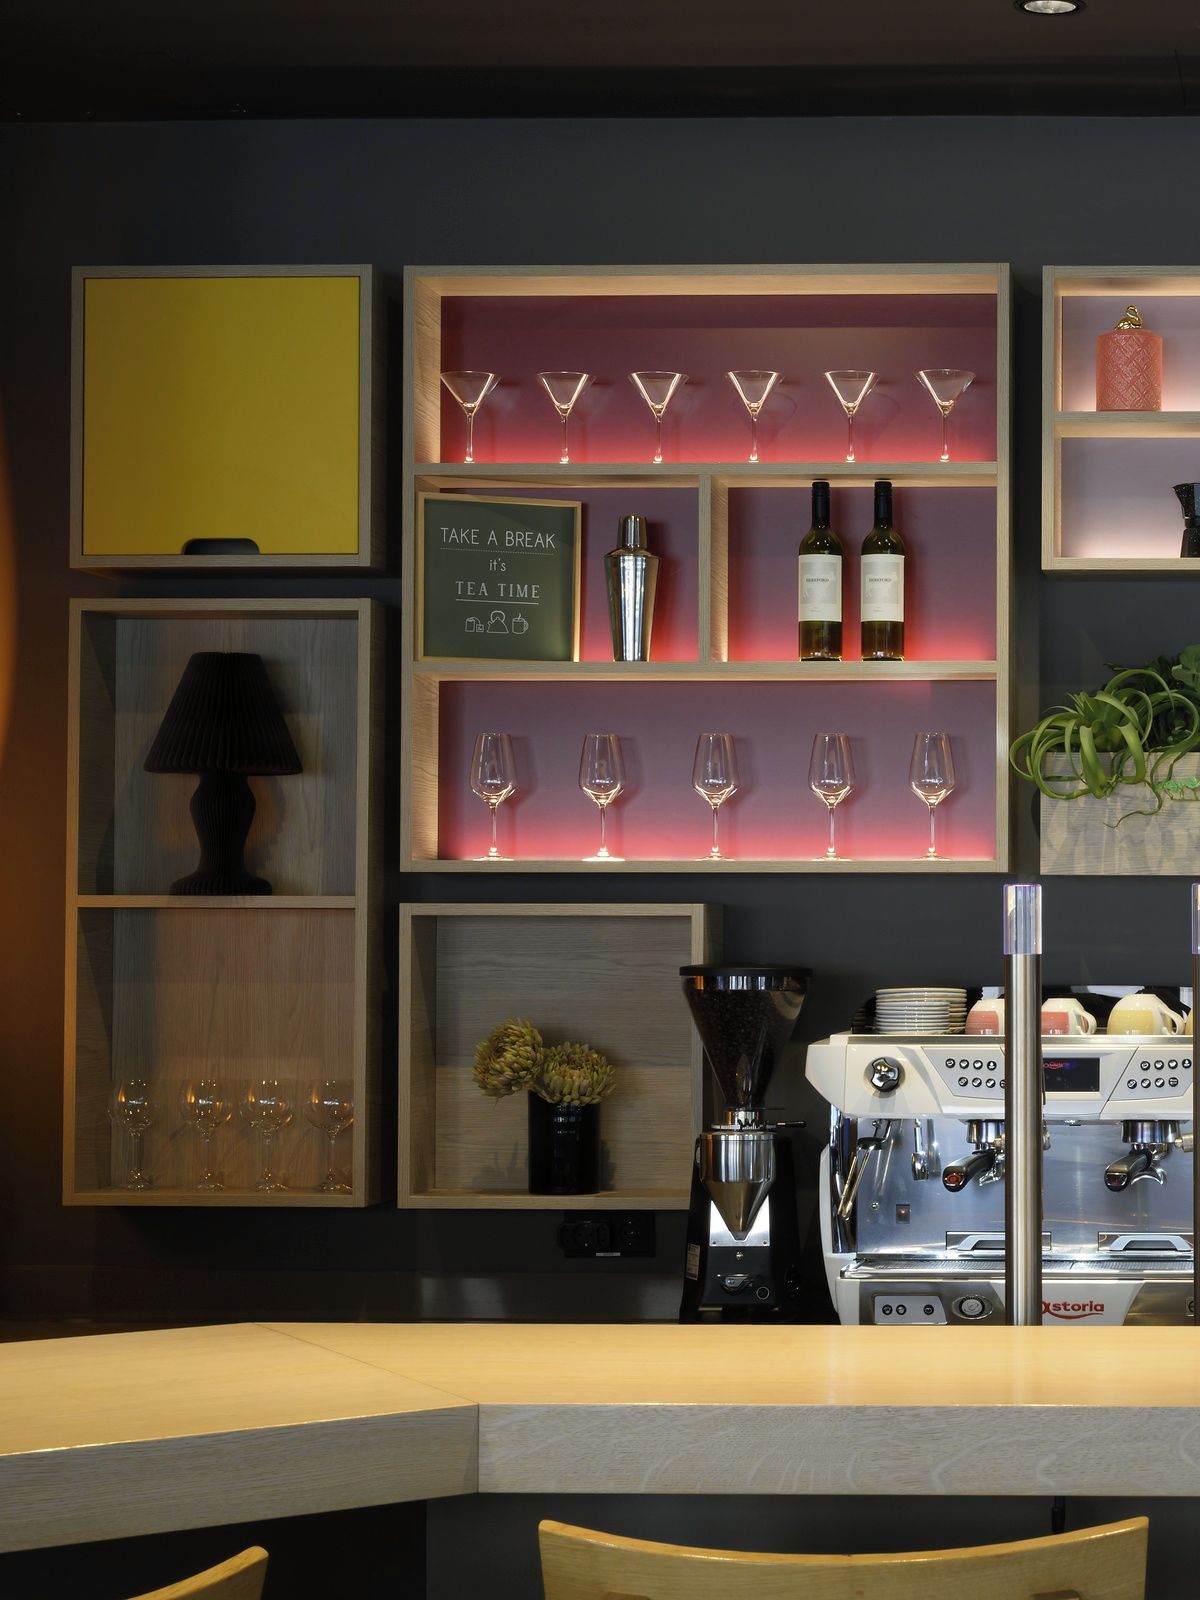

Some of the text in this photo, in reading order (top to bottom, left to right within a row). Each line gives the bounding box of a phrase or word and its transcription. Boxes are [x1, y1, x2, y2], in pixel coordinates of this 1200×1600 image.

[440, 527, 556, 549] TAKE A BREAK
[489, 558, 507, 572] it's
[455, 581, 541, 599] TEA TIME
